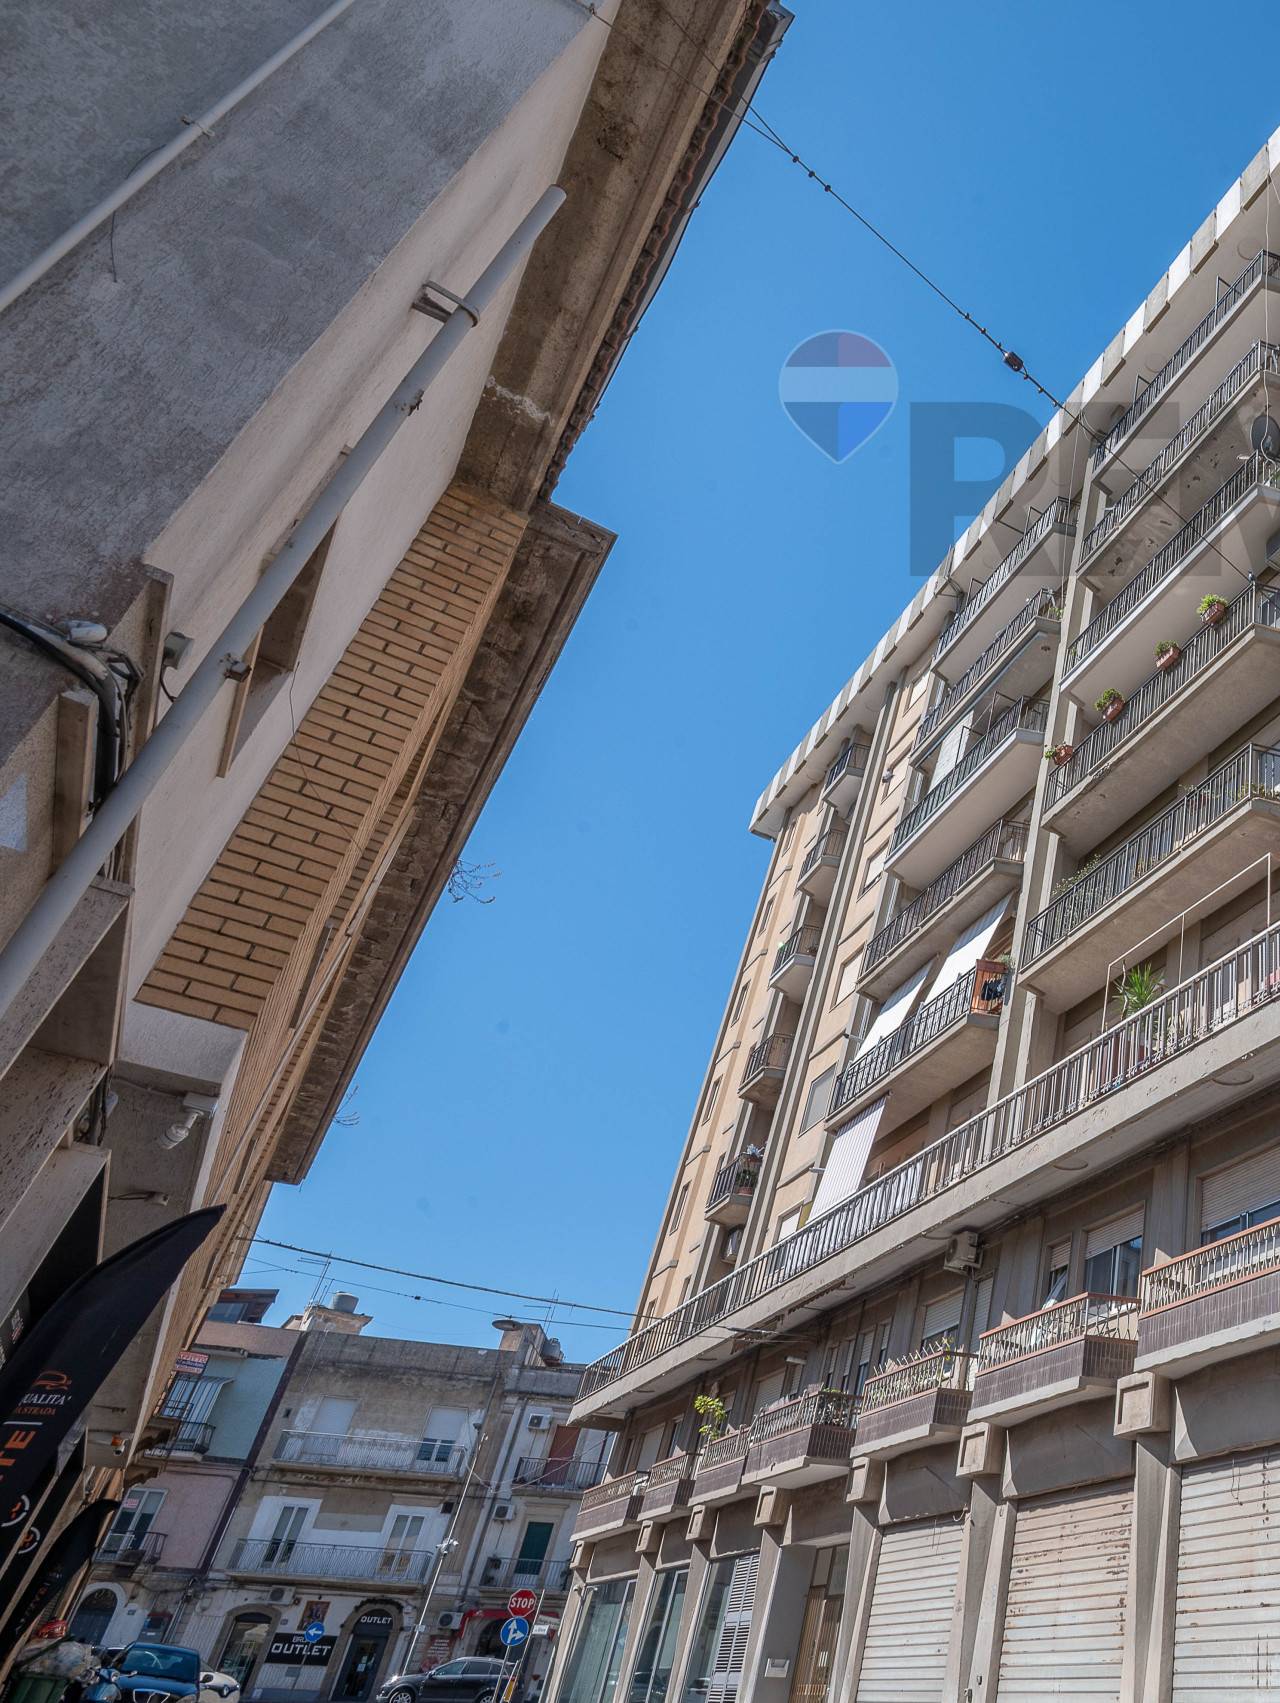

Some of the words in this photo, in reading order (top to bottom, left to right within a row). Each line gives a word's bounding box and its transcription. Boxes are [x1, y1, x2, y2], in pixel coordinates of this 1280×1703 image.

[510, 1597, 536, 1609] STOP
[360, 1615, 393, 1625] OUTLET
[271, 1642, 332, 1656] OUTLET
